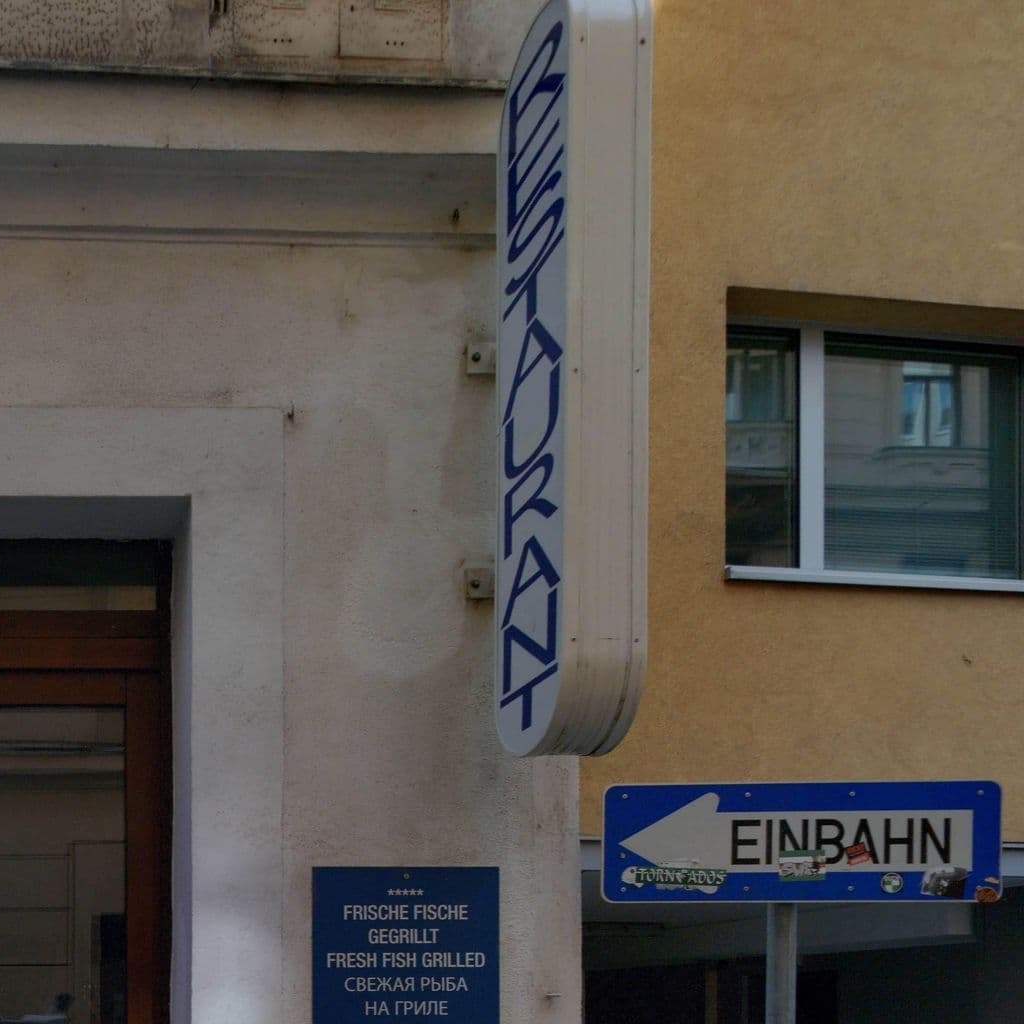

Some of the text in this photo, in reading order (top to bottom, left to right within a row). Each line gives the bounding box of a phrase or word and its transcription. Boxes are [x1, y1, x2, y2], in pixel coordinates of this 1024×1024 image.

[500, 21, 566, 731] RESTAURANT
[731, 818, 952, 865] EINBAHN
[344, 905, 468, 920] FRISCHE FISCHE
[369, 929, 439, 944] GEGRILLT
[327, 952, 485, 968] FRESH FISH GRILLED
[345, 977, 468, 991] СВЕЖАЯ РЫБА
[366, 1001, 448, 1015] НА ГРИЛЕ
